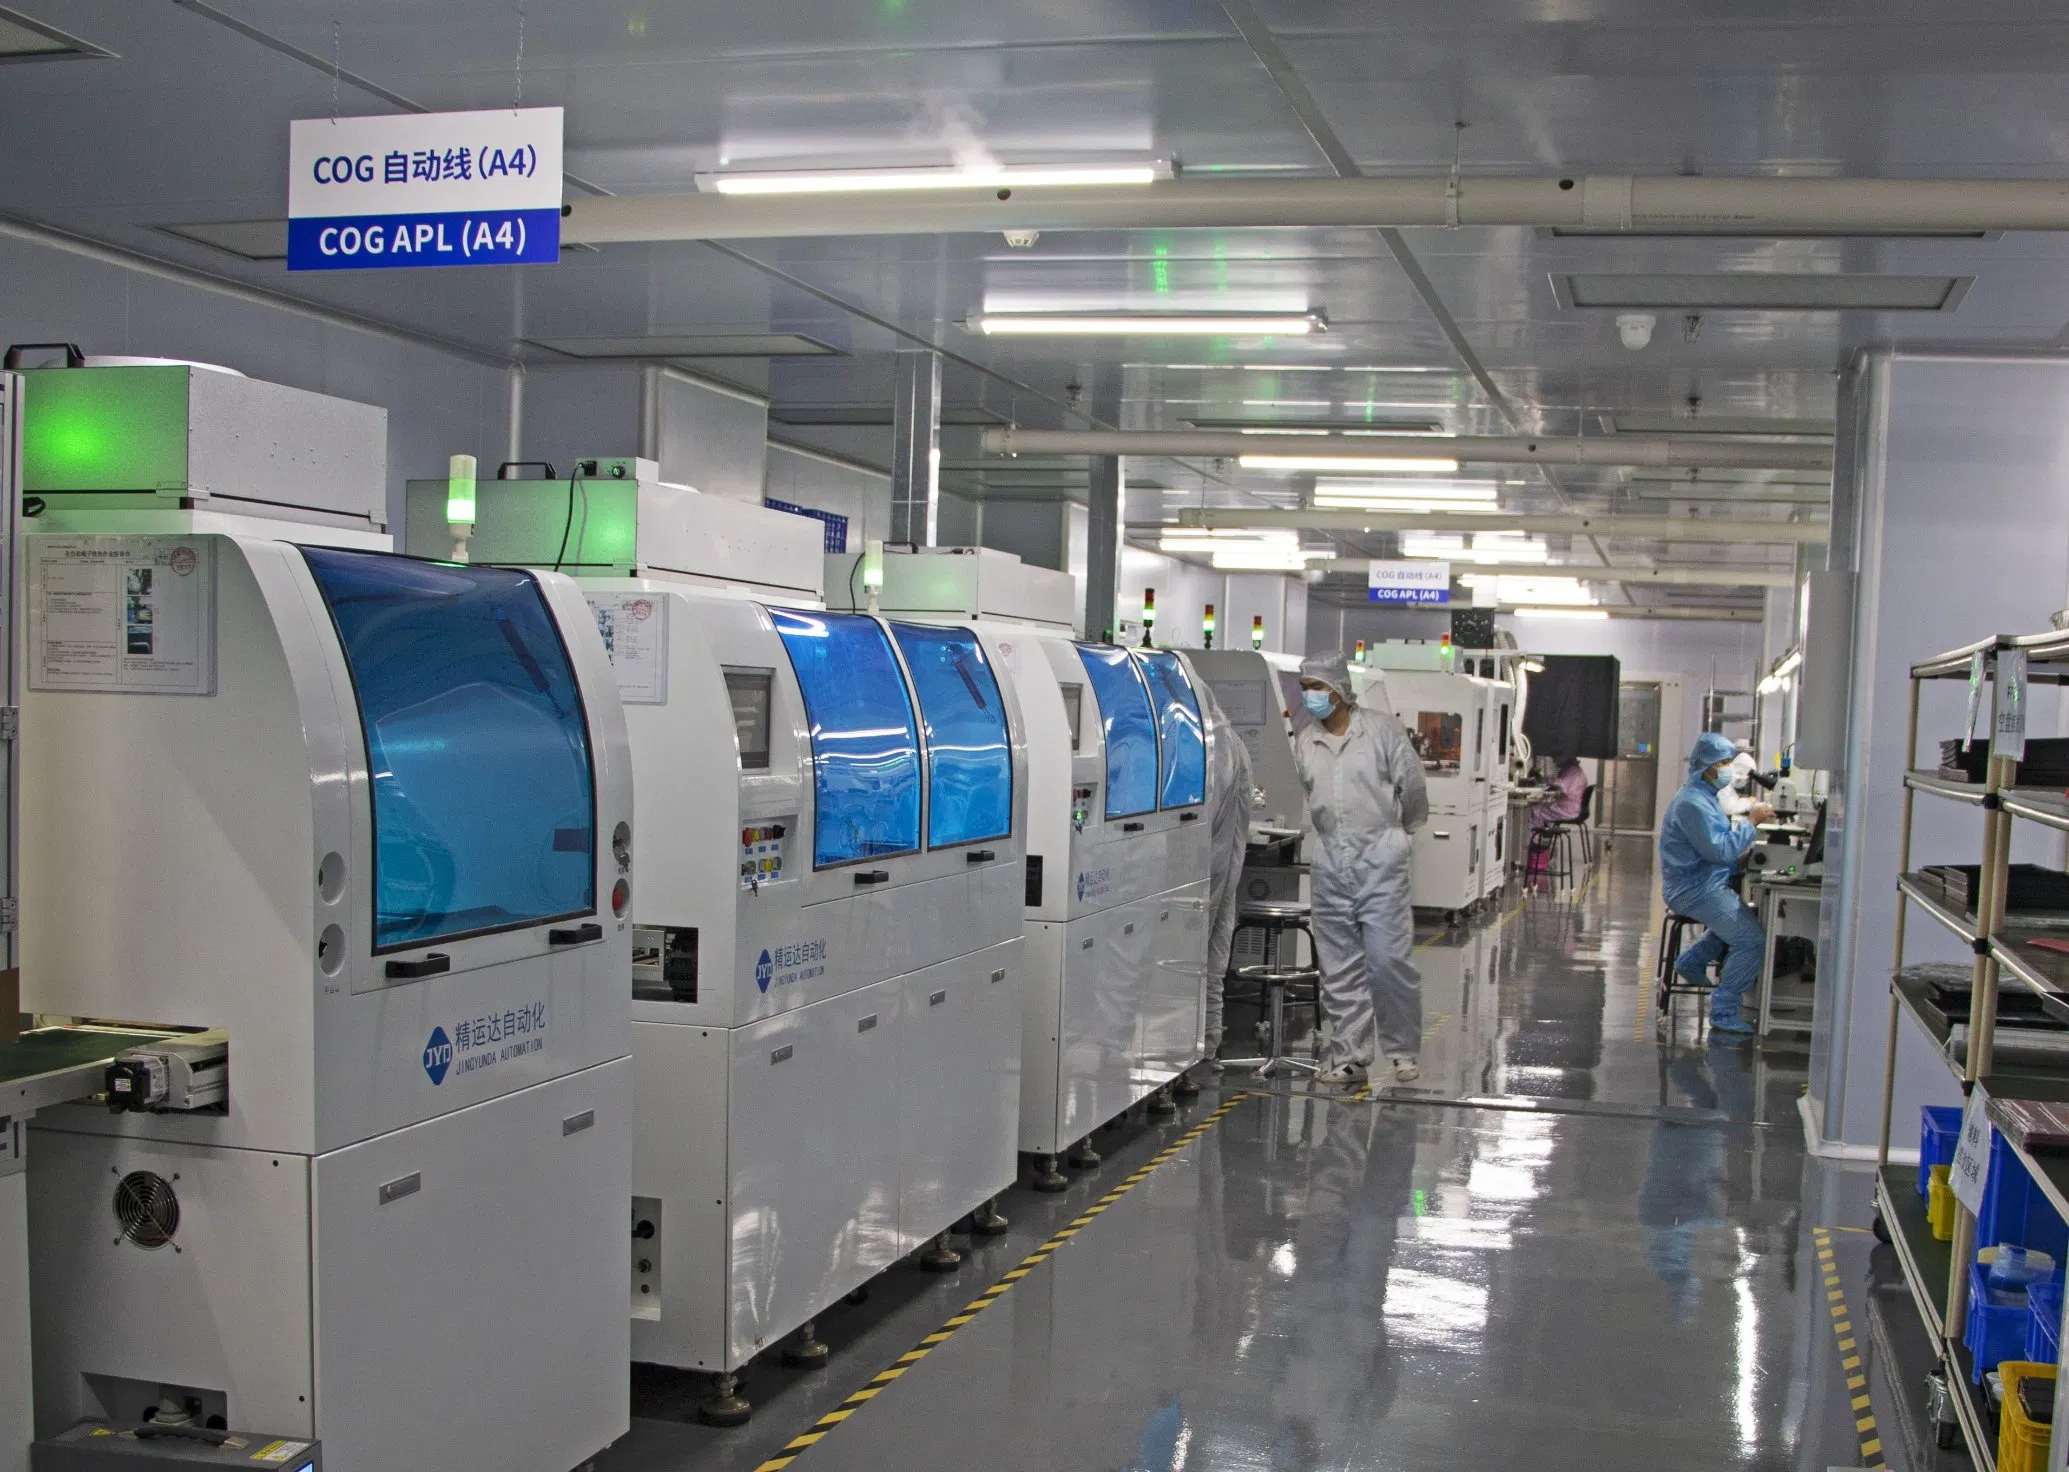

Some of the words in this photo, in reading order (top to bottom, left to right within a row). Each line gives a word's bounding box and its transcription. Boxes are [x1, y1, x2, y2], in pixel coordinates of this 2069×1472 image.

[313, 154, 374, 185] COG
[319, 225, 384, 256] COG
[391, 223, 453, 253] APL
[462, 217, 526, 258] (A4)
[1376, 570, 1395, 580] COG
[1377, 589, 1397, 599] COG
[1399, 590, 1418, 600] APL
[1419, 590, 1440, 601] (A4)
[774, 938, 827, 971] 精运达自动化
[455, 1001, 546, 1053] 精运达自动化
[426, 1043, 452, 1068] JYD
[456, 1052, 497, 1075] JINGYUNDA
[500, 1038, 543, 1061] AUTOMATION
